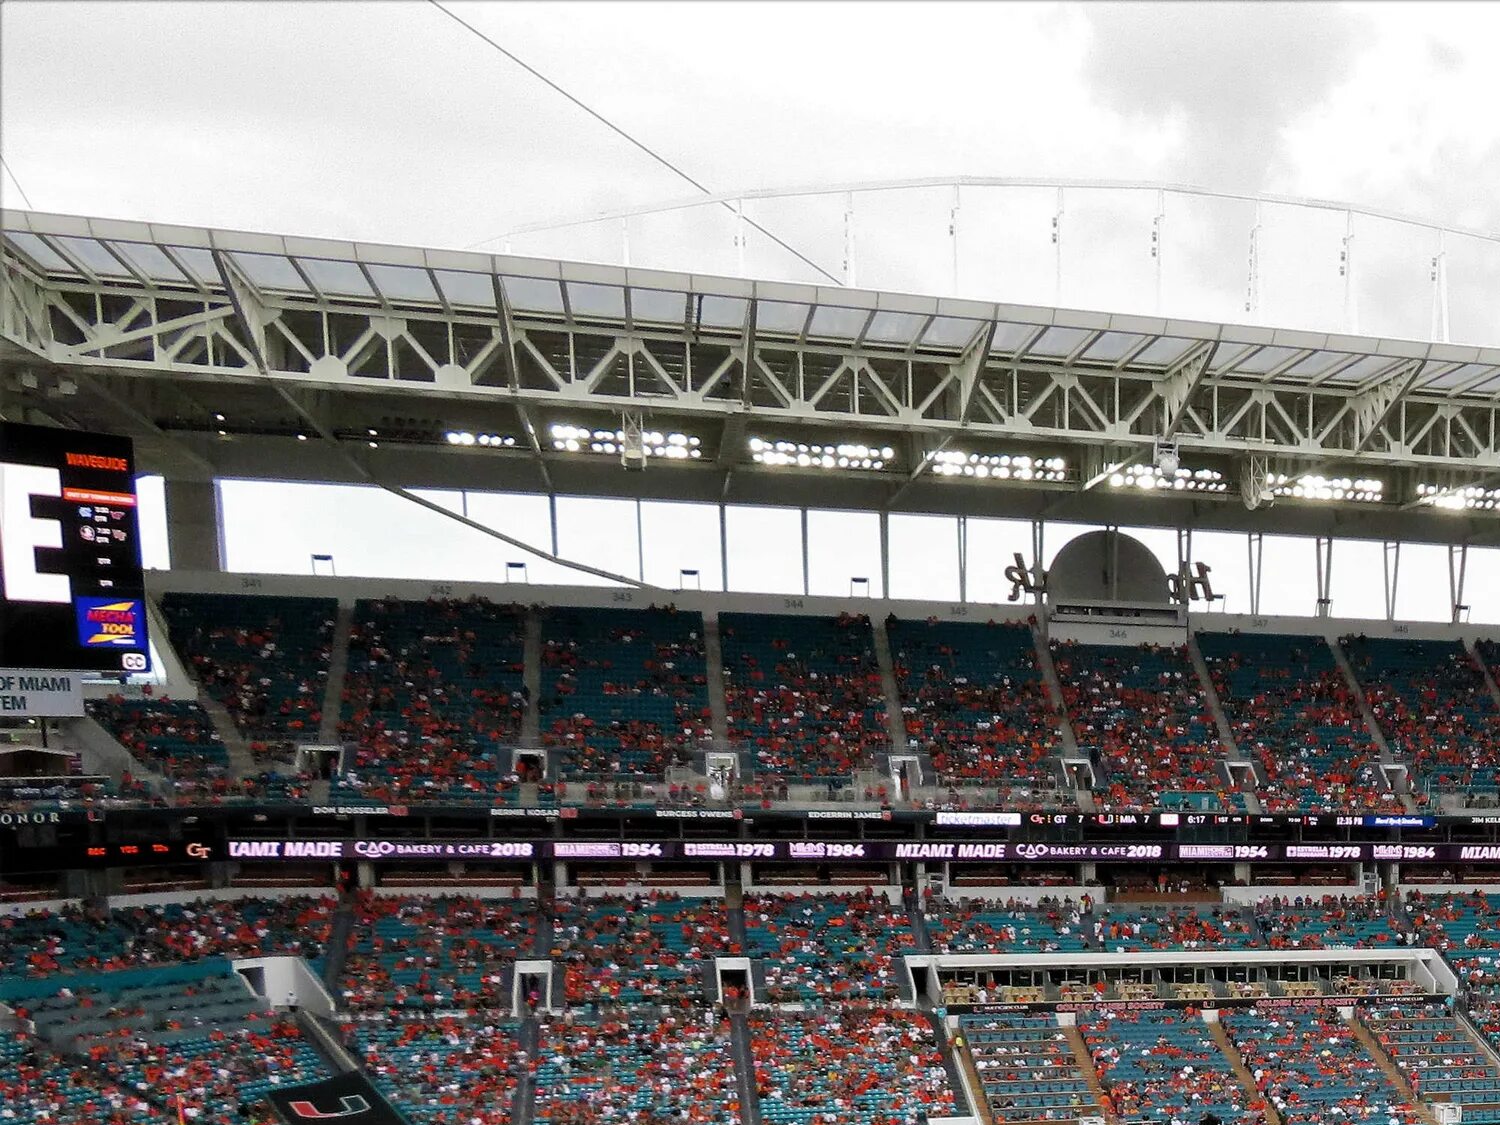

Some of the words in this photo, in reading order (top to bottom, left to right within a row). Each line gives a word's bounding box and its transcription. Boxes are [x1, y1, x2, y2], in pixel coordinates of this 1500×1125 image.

[613, 592, 632, 601] 343
[102, 623, 135, 634] TOOL
[1109, 630, 1127, 639] 346
[125, 656, 144, 667] CC
[19, 677, 71, 691] MIAMI
[1, 812, 60, 824] ONOR
[1054, 815, 1067, 823] GT
[1078, 815, 1083, 823] 7
[1120, 815, 1136, 823] MIA
[1144, 815, 1149, 823] 7
[1188, 815, 1205, 824] 6:17
[284, 842, 342, 857] MADE
[397, 845, 441, 854] BAKERY
[459, 845, 489, 854] CAFE
[491, 843, 533, 856] 2018
[622, 844, 662, 856] 1954
[737, 844, 774, 857] 1978
[826, 844, 865, 857] 1984
[896, 844, 954, 858] MIAMI
[958, 844, 1005, 858] MADE
[1050, 846, 1087, 855] BAKERY
[1091, 847, 1097, 855] &
[1101, 847, 1126, 855] CAFE
[1127, 845, 1161, 858] 2018
[1235, 846, 1267, 858] 1954
[1330, 846, 1361, 858] 1978
[1404, 847, 1436, 859] 1984
[288, 1095, 371, 1119] U
